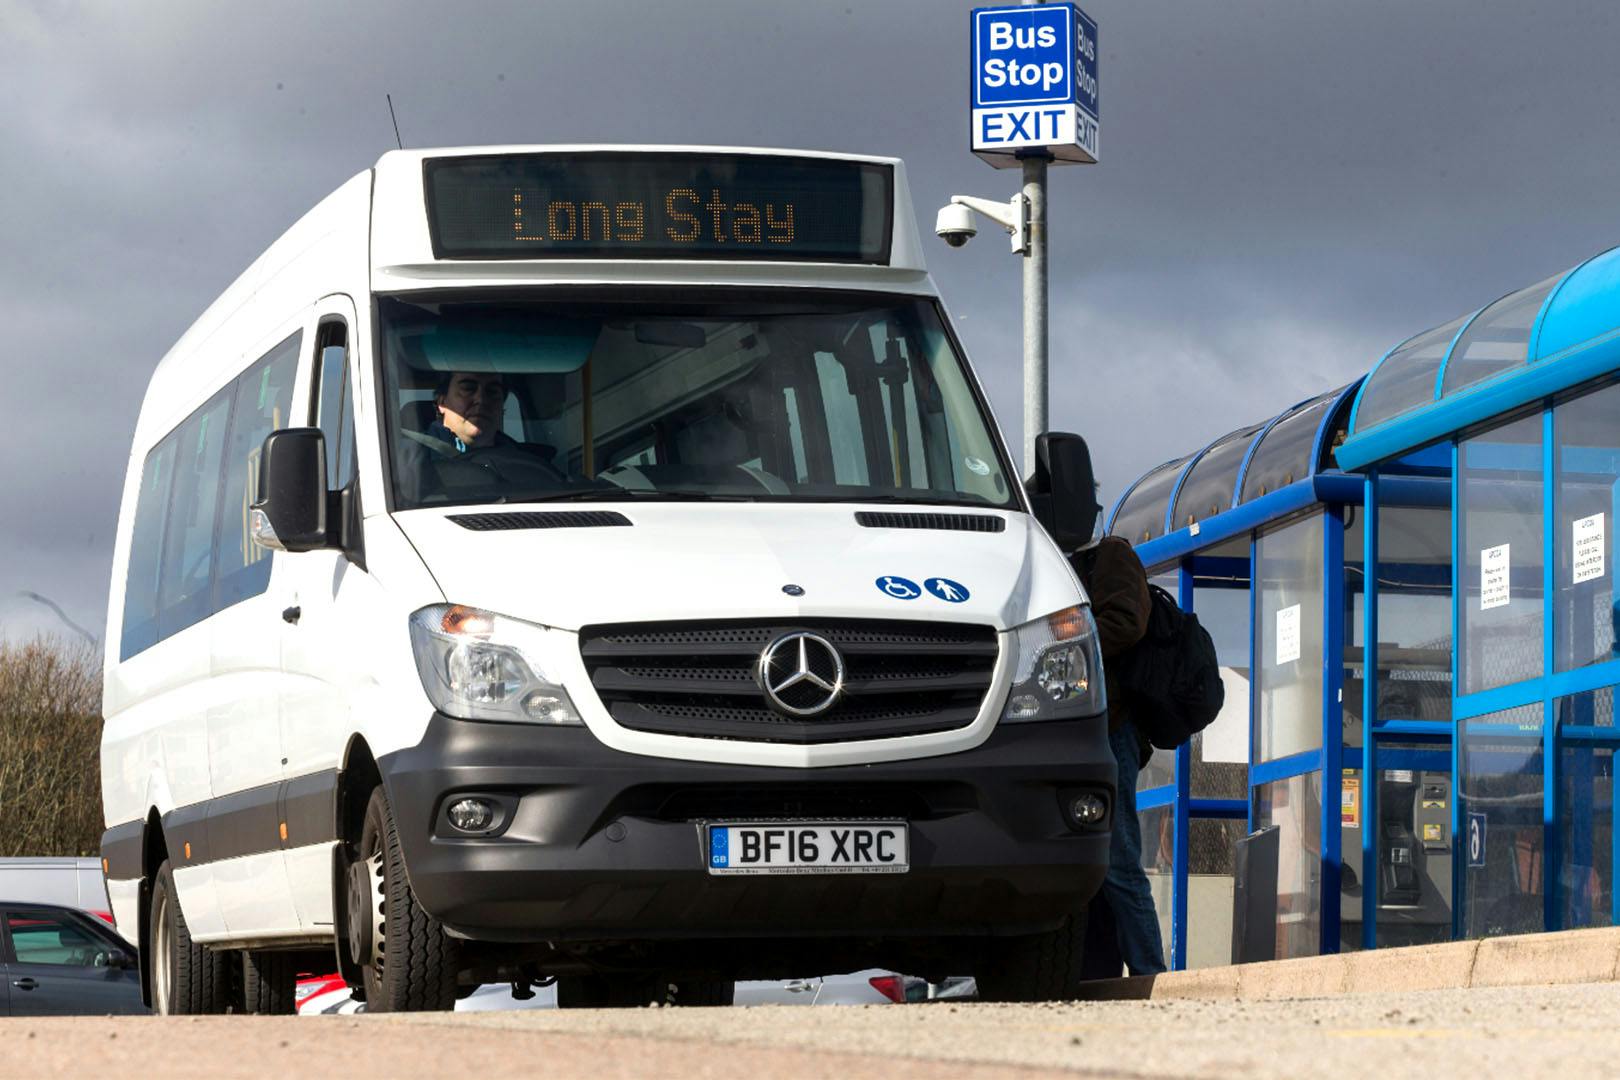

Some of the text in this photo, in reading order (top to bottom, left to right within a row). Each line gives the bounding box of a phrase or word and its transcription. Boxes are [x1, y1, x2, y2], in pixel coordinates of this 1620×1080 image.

[990, 22, 1056, 50] Bus
[1077, 23, 1094, 61] Bus
[984, 58, 1063, 91] Stop
[1076, 60, 1097, 104] Stop
[982, 110, 1066, 143] EXIT
[1077, 113, 1097, 154] EXIT
[514, 187, 794, 243] Long Stay
[712, 855, 727, 863] GB
[740, 830, 896, 863] BF16 XRC
